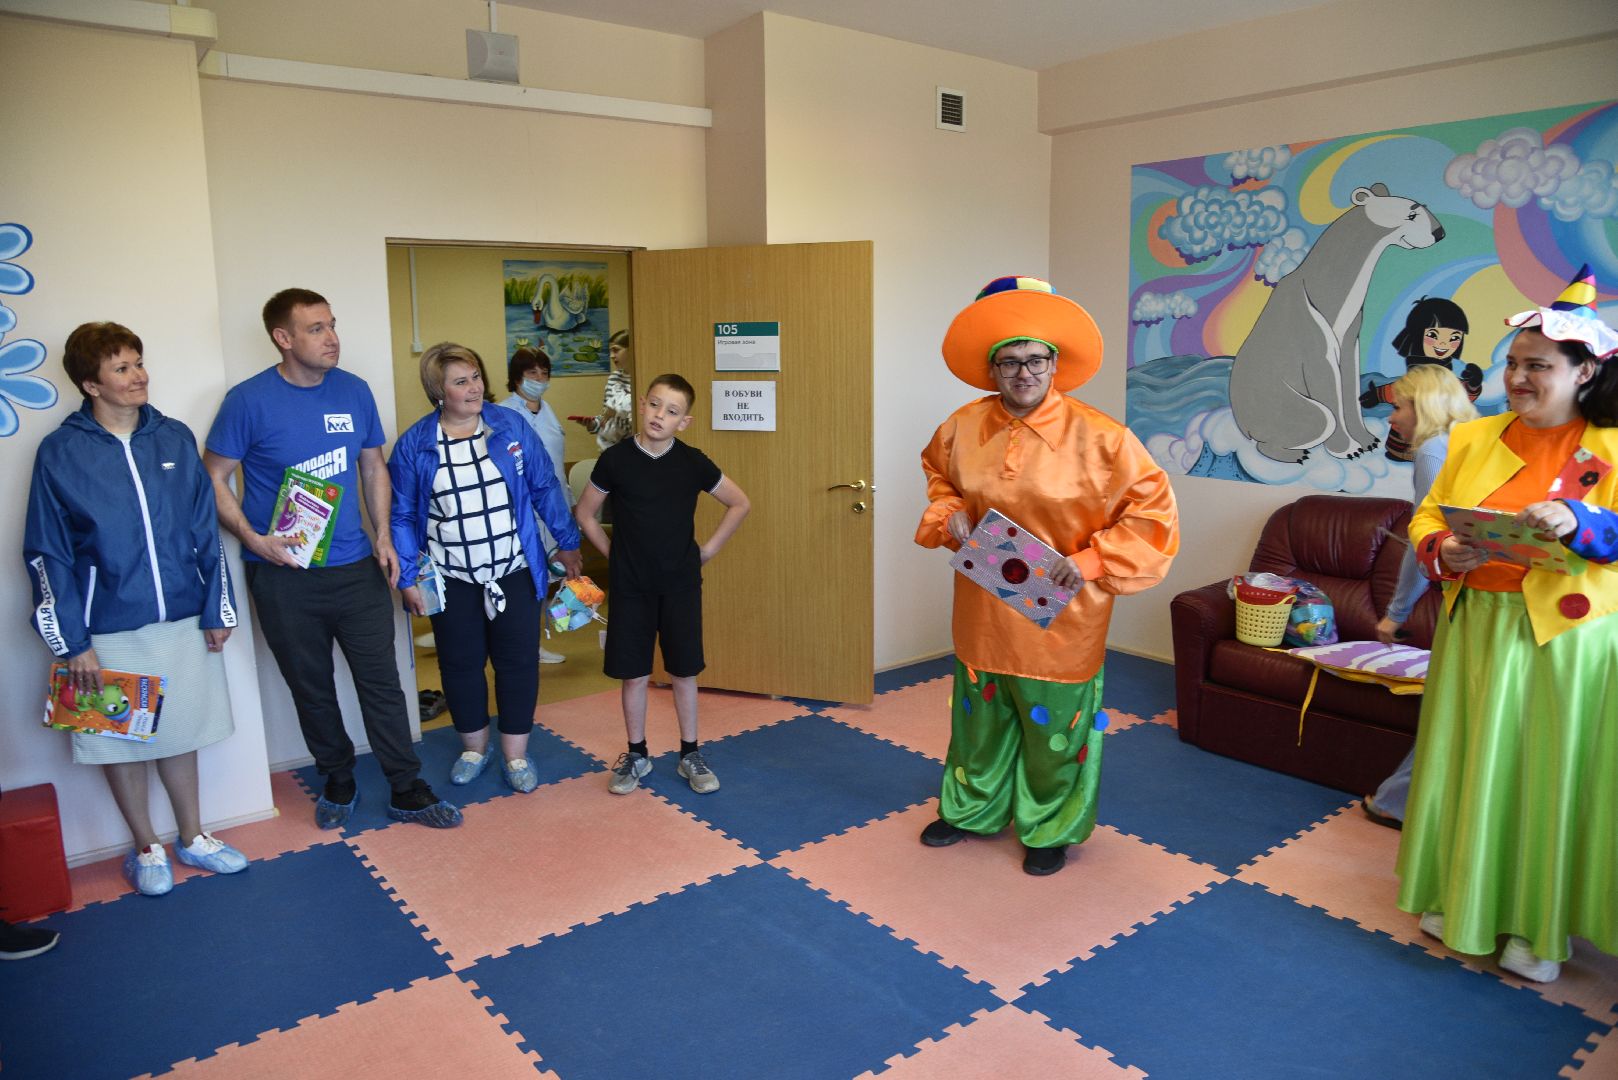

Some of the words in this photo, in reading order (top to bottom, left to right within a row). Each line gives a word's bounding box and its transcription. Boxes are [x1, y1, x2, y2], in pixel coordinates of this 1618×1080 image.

[718, 325, 738, 334] 105
[723, 413, 764, 422] ВХОДИТЬ
[291, 446, 347, 474] ОЛОДАЯ
[41, 607, 62, 652] ЕДИНАЯ
